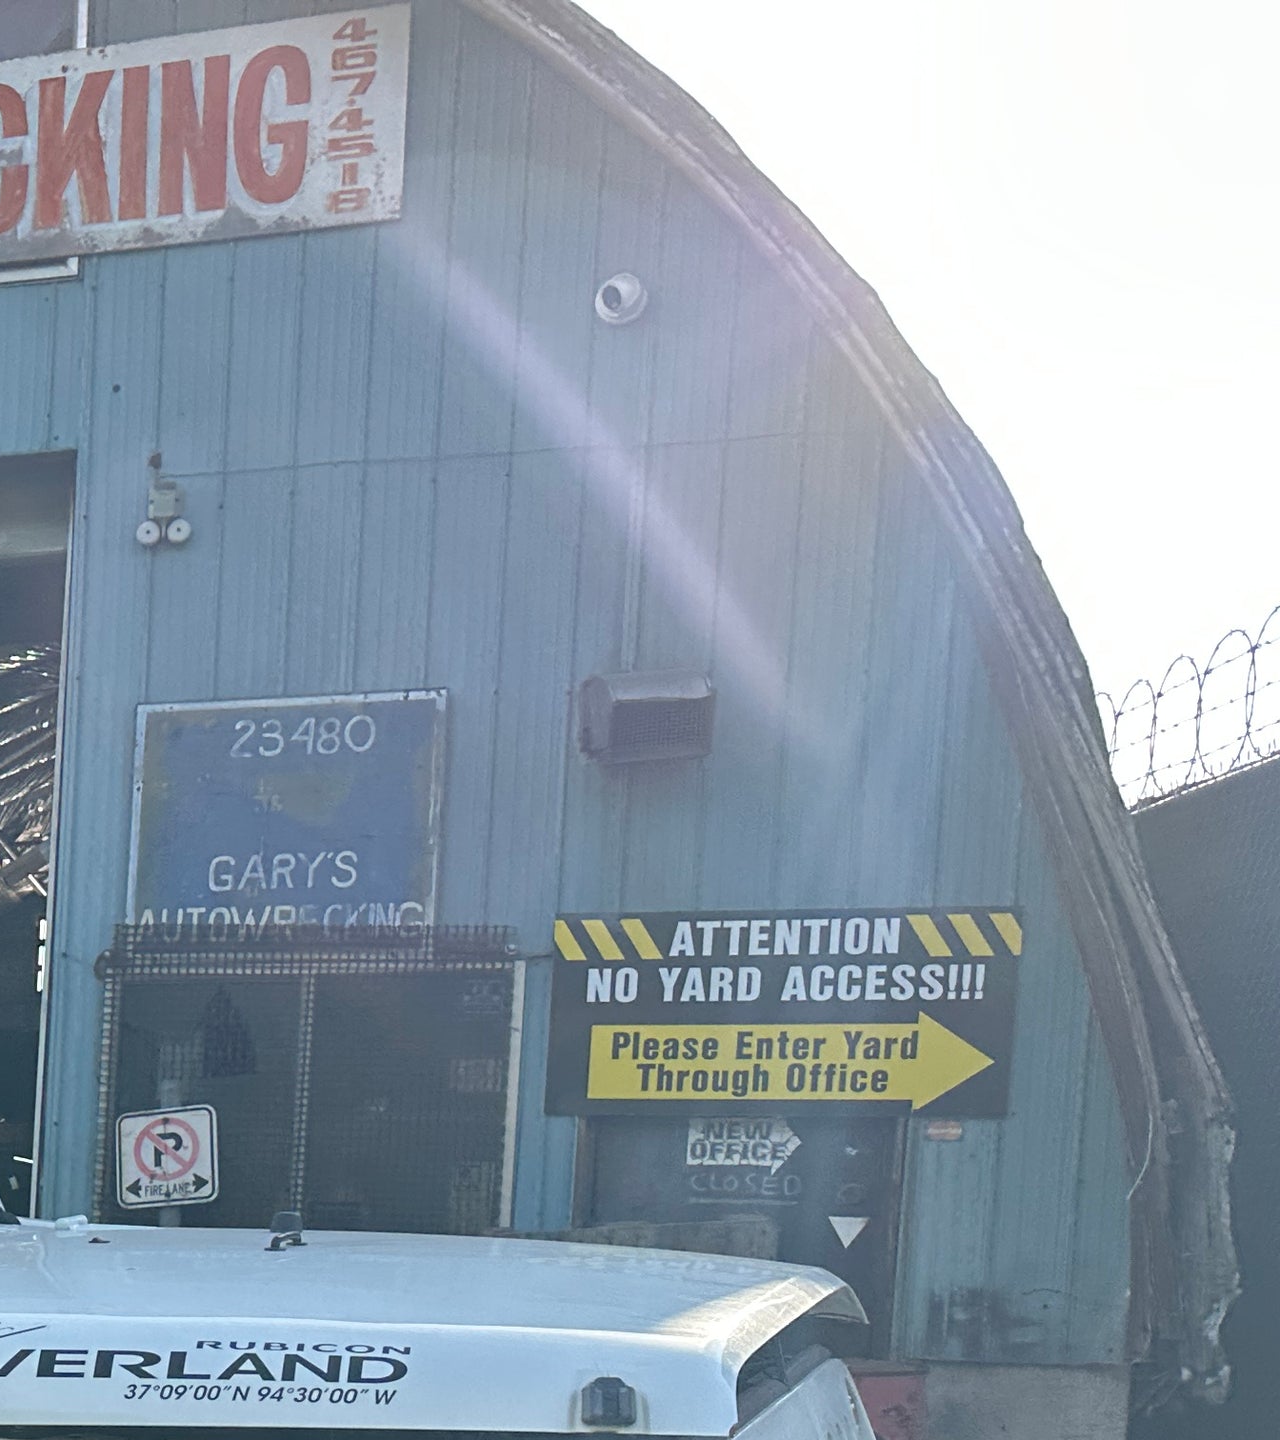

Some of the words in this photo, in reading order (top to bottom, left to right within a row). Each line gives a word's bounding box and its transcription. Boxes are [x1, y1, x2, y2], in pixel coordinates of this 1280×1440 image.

[230, 714, 377, 758] 23480
[208, 850, 359, 892] GARY'S
[669, 917, 901, 957] ATTENTION
[586, 967, 639, 1003] NO
[658, 966, 762, 1003] YARD
[780, 963, 986, 1001] ACCESS!!!
[610, 1030, 719, 1061] Please
[736, 1030, 827, 1061] Enter
[843, 1030, 919, 1061] Yard
[636, 1063, 769, 1098] Through
[785, 1063, 889, 1094] Office
[702, 1119, 770, 1140] NEW
[690, 1140, 791, 1163] OFFICE
[144, 1184, 165, 1197] FIRE
[691, 1173, 802, 1197] CLOSED
[196, 1339, 412, 1356] RUBICON
